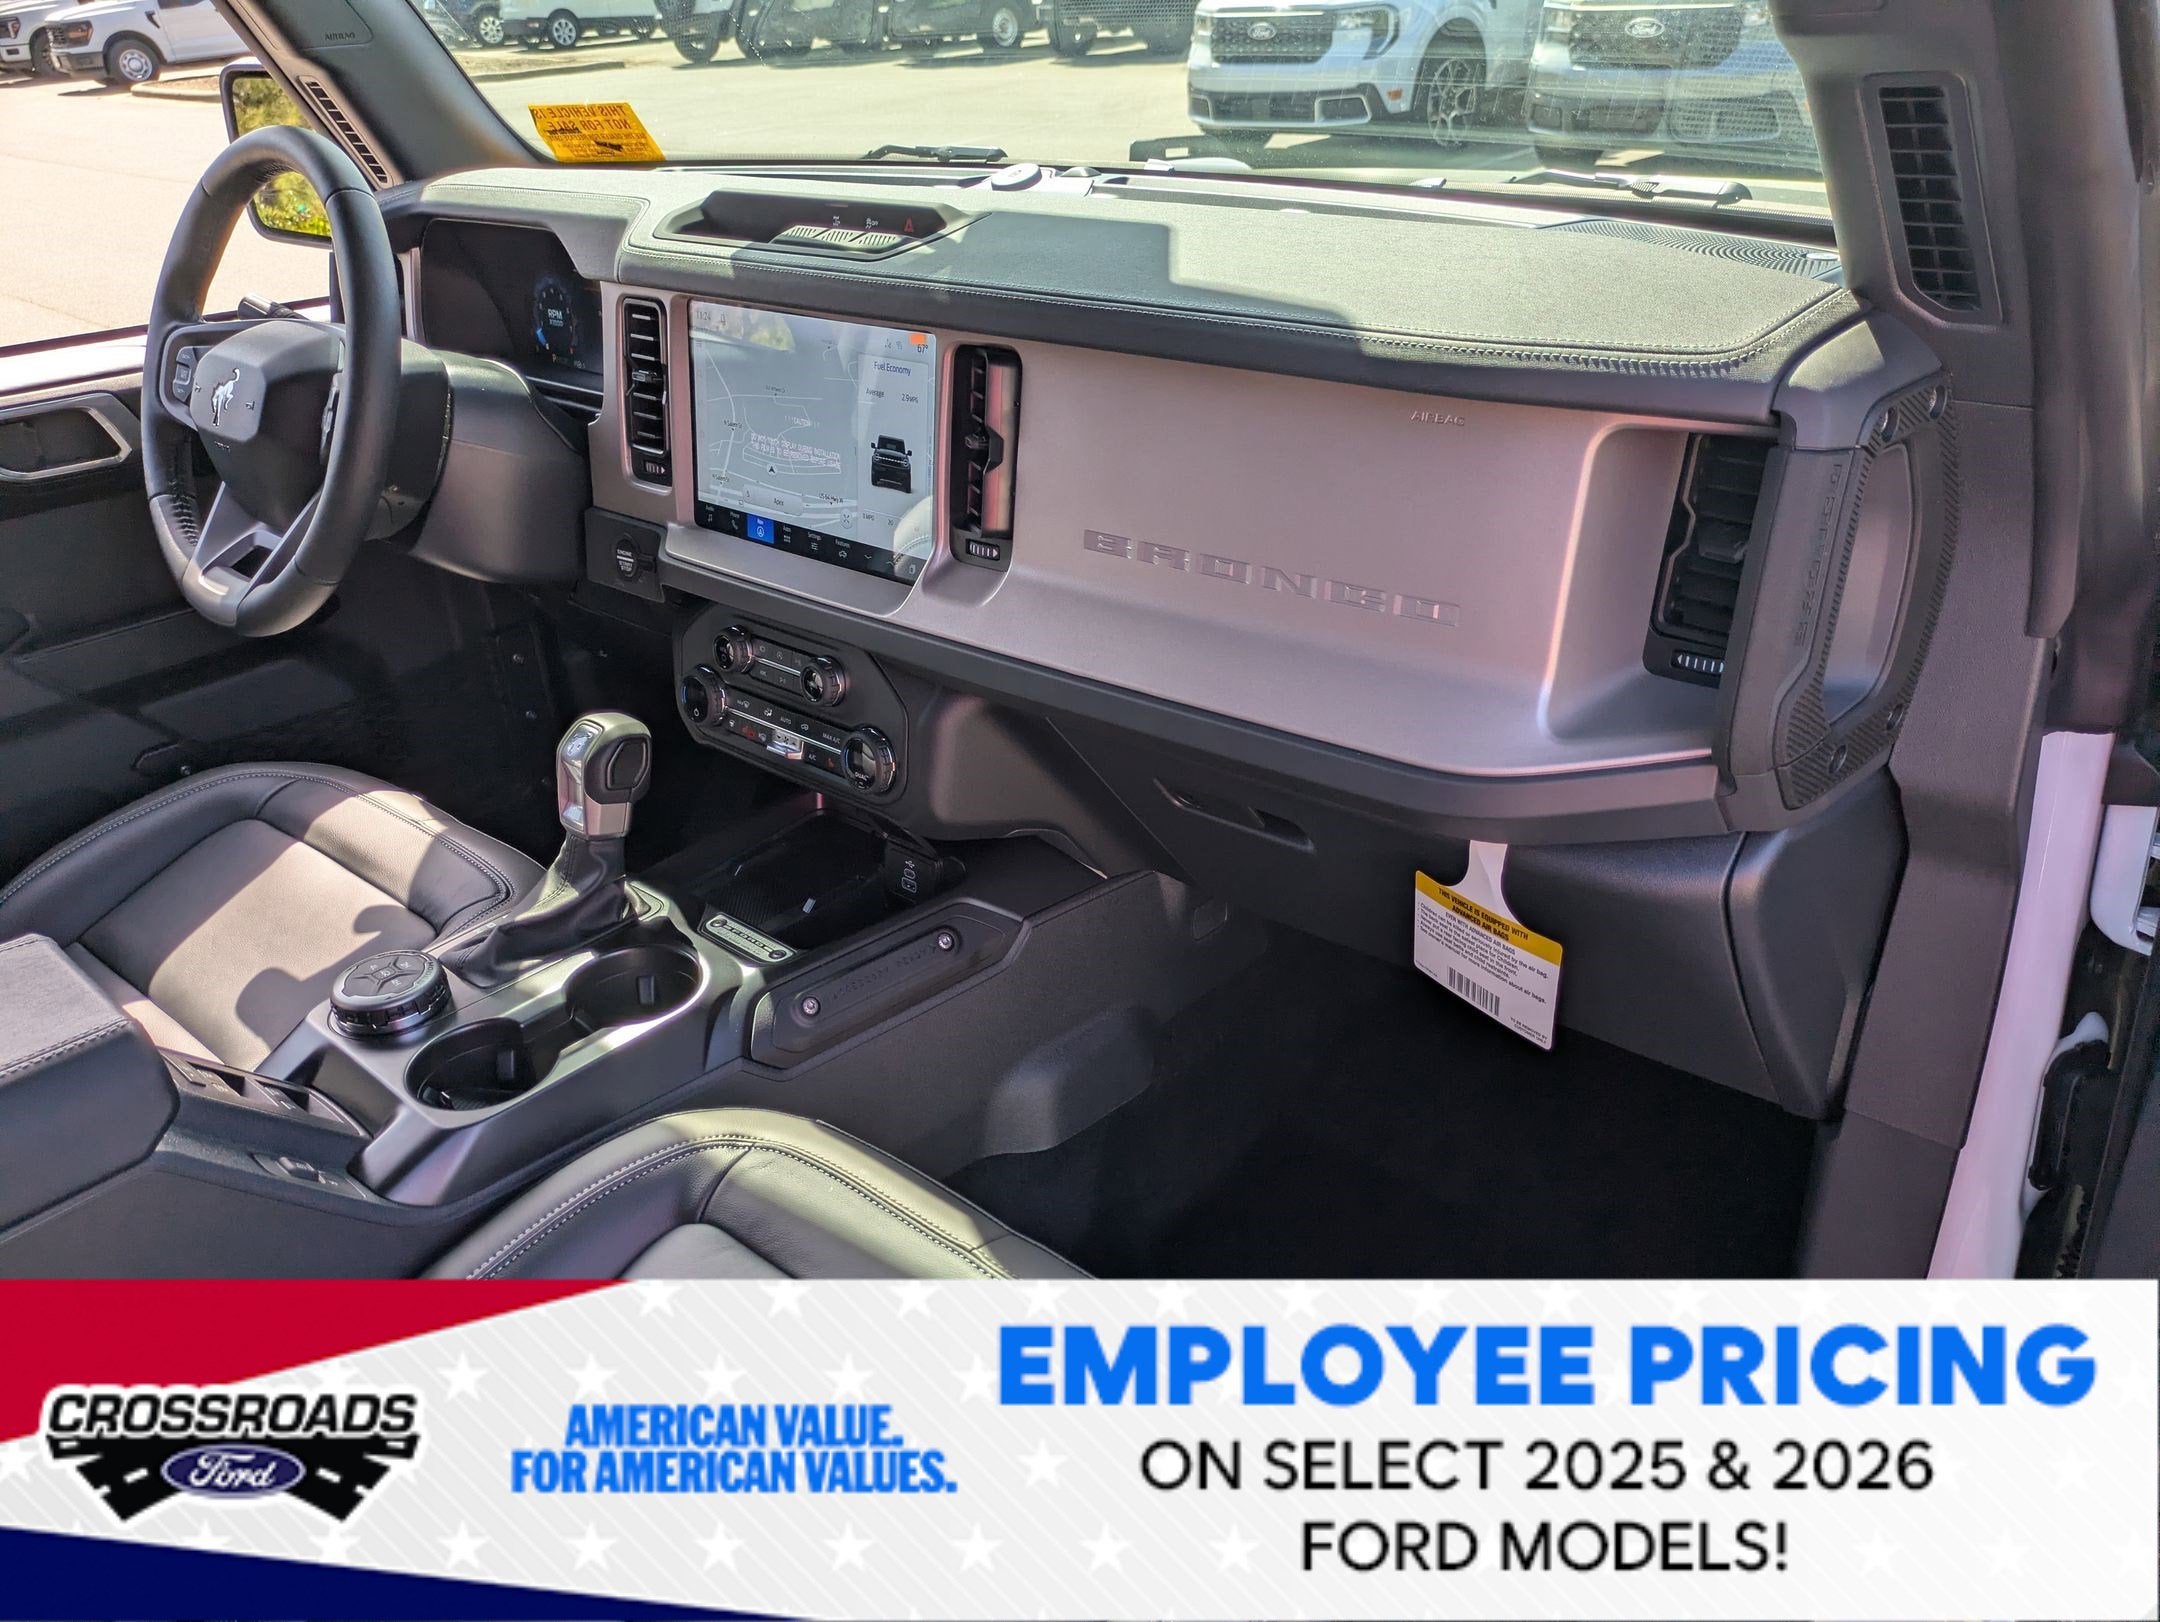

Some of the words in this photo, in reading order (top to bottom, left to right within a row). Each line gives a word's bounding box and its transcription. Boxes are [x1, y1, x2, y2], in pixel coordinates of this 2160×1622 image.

[548, 308, 564, 320] RPM
[874, 361, 886, 371] Fuel
[886, 363, 912, 376] Economy
[866, 388, 886, 398] Average
[1409, 410, 1465, 427] AIRBAG
[1083, 528, 1462, 628] BRONCO
[1438, 888, 1450, 900] THIS
[1451, 896, 1473, 913] VEHICLE
[1474, 908, 1480, 917] IS
[1481, 912, 1510, 932] EQUIPPED
[1511, 927, 1529, 940] WITH
[1452, 904, 1480, 926] ADVANCED
[1482, 922, 1492, 934] AIR
[1493, 928, 1509, 941] BAGS
[1469, 926, 1492, 943] ADVANCED
